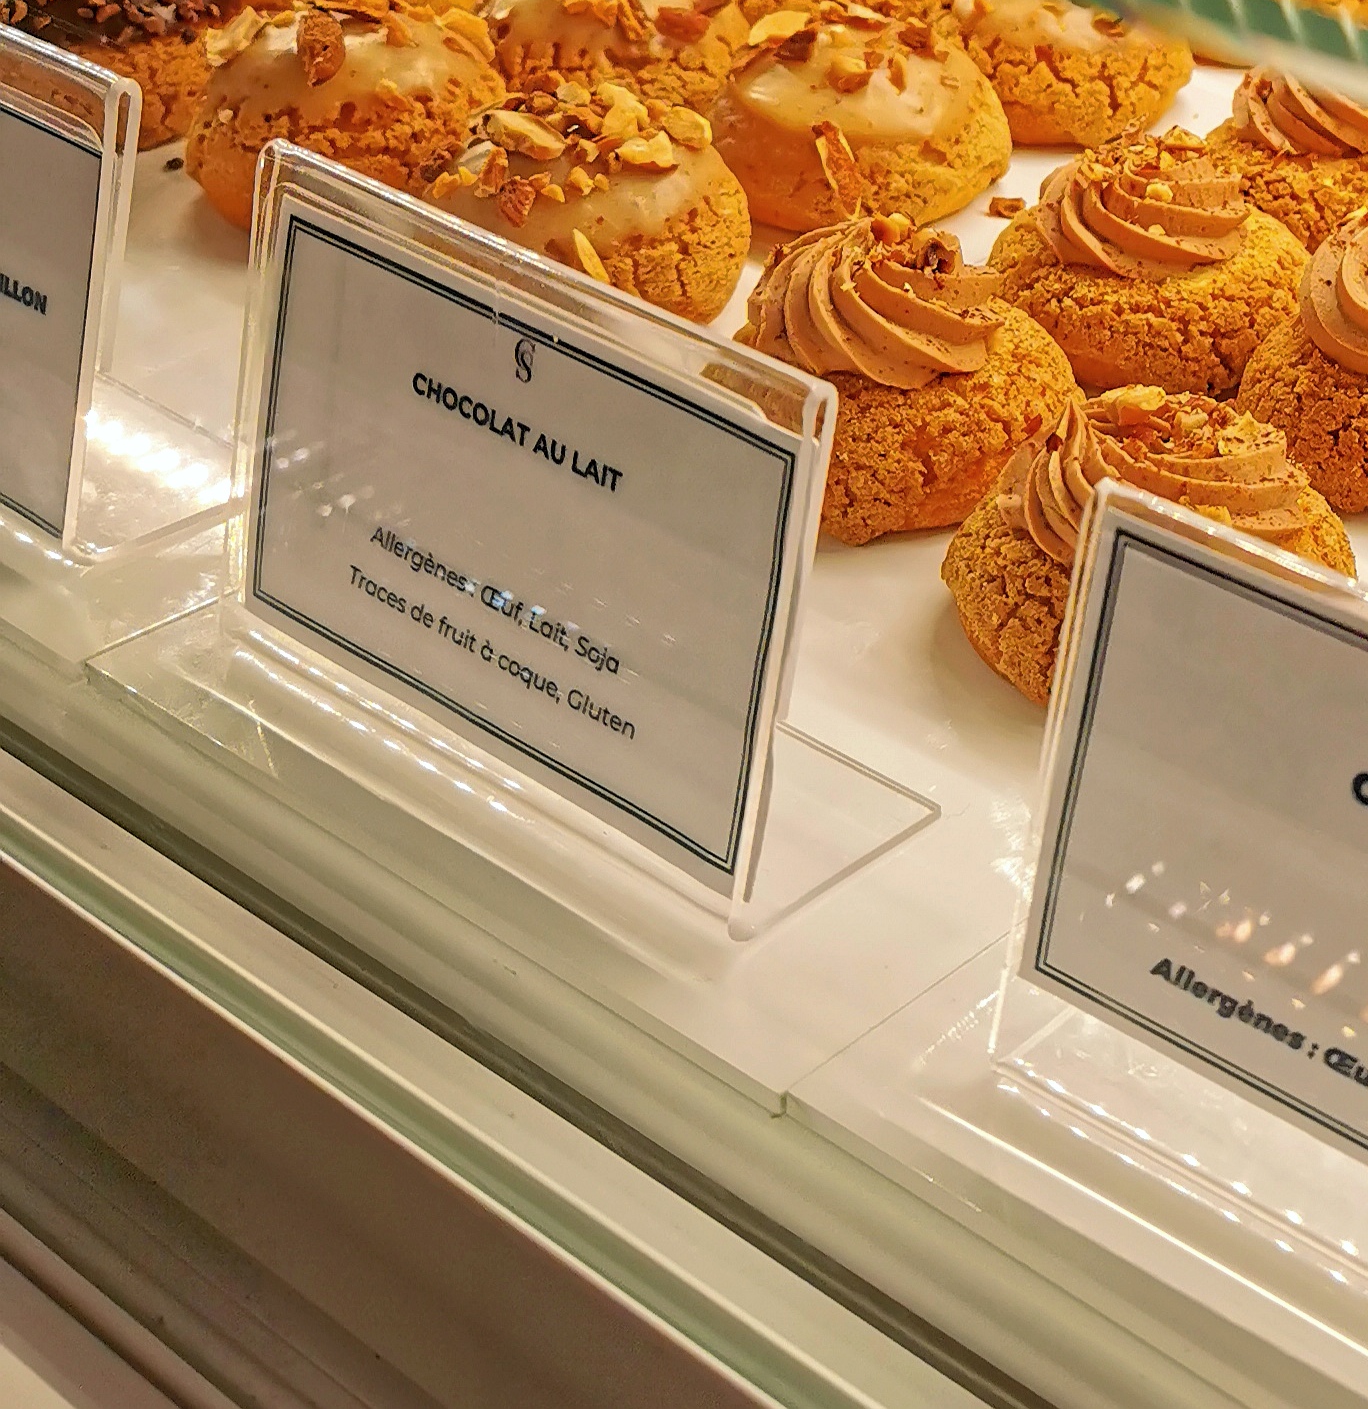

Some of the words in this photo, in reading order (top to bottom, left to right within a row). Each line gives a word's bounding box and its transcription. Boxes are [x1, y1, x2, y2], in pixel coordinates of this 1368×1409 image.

[412, 372, 531, 447] CHOCOLAT
[533, 433, 567, 466] AU
[571, 450, 624, 492] LAIT
[350, 564, 406, 614] Traces
[410, 603, 434, 629] de
[437, 616, 477, 654] fruit
[480, 639, 494, 663] à
[498, 652, 561, 704] coque,
[567, 688, 636, 740] Gluten
[574, 635, 620, 675] Soja
